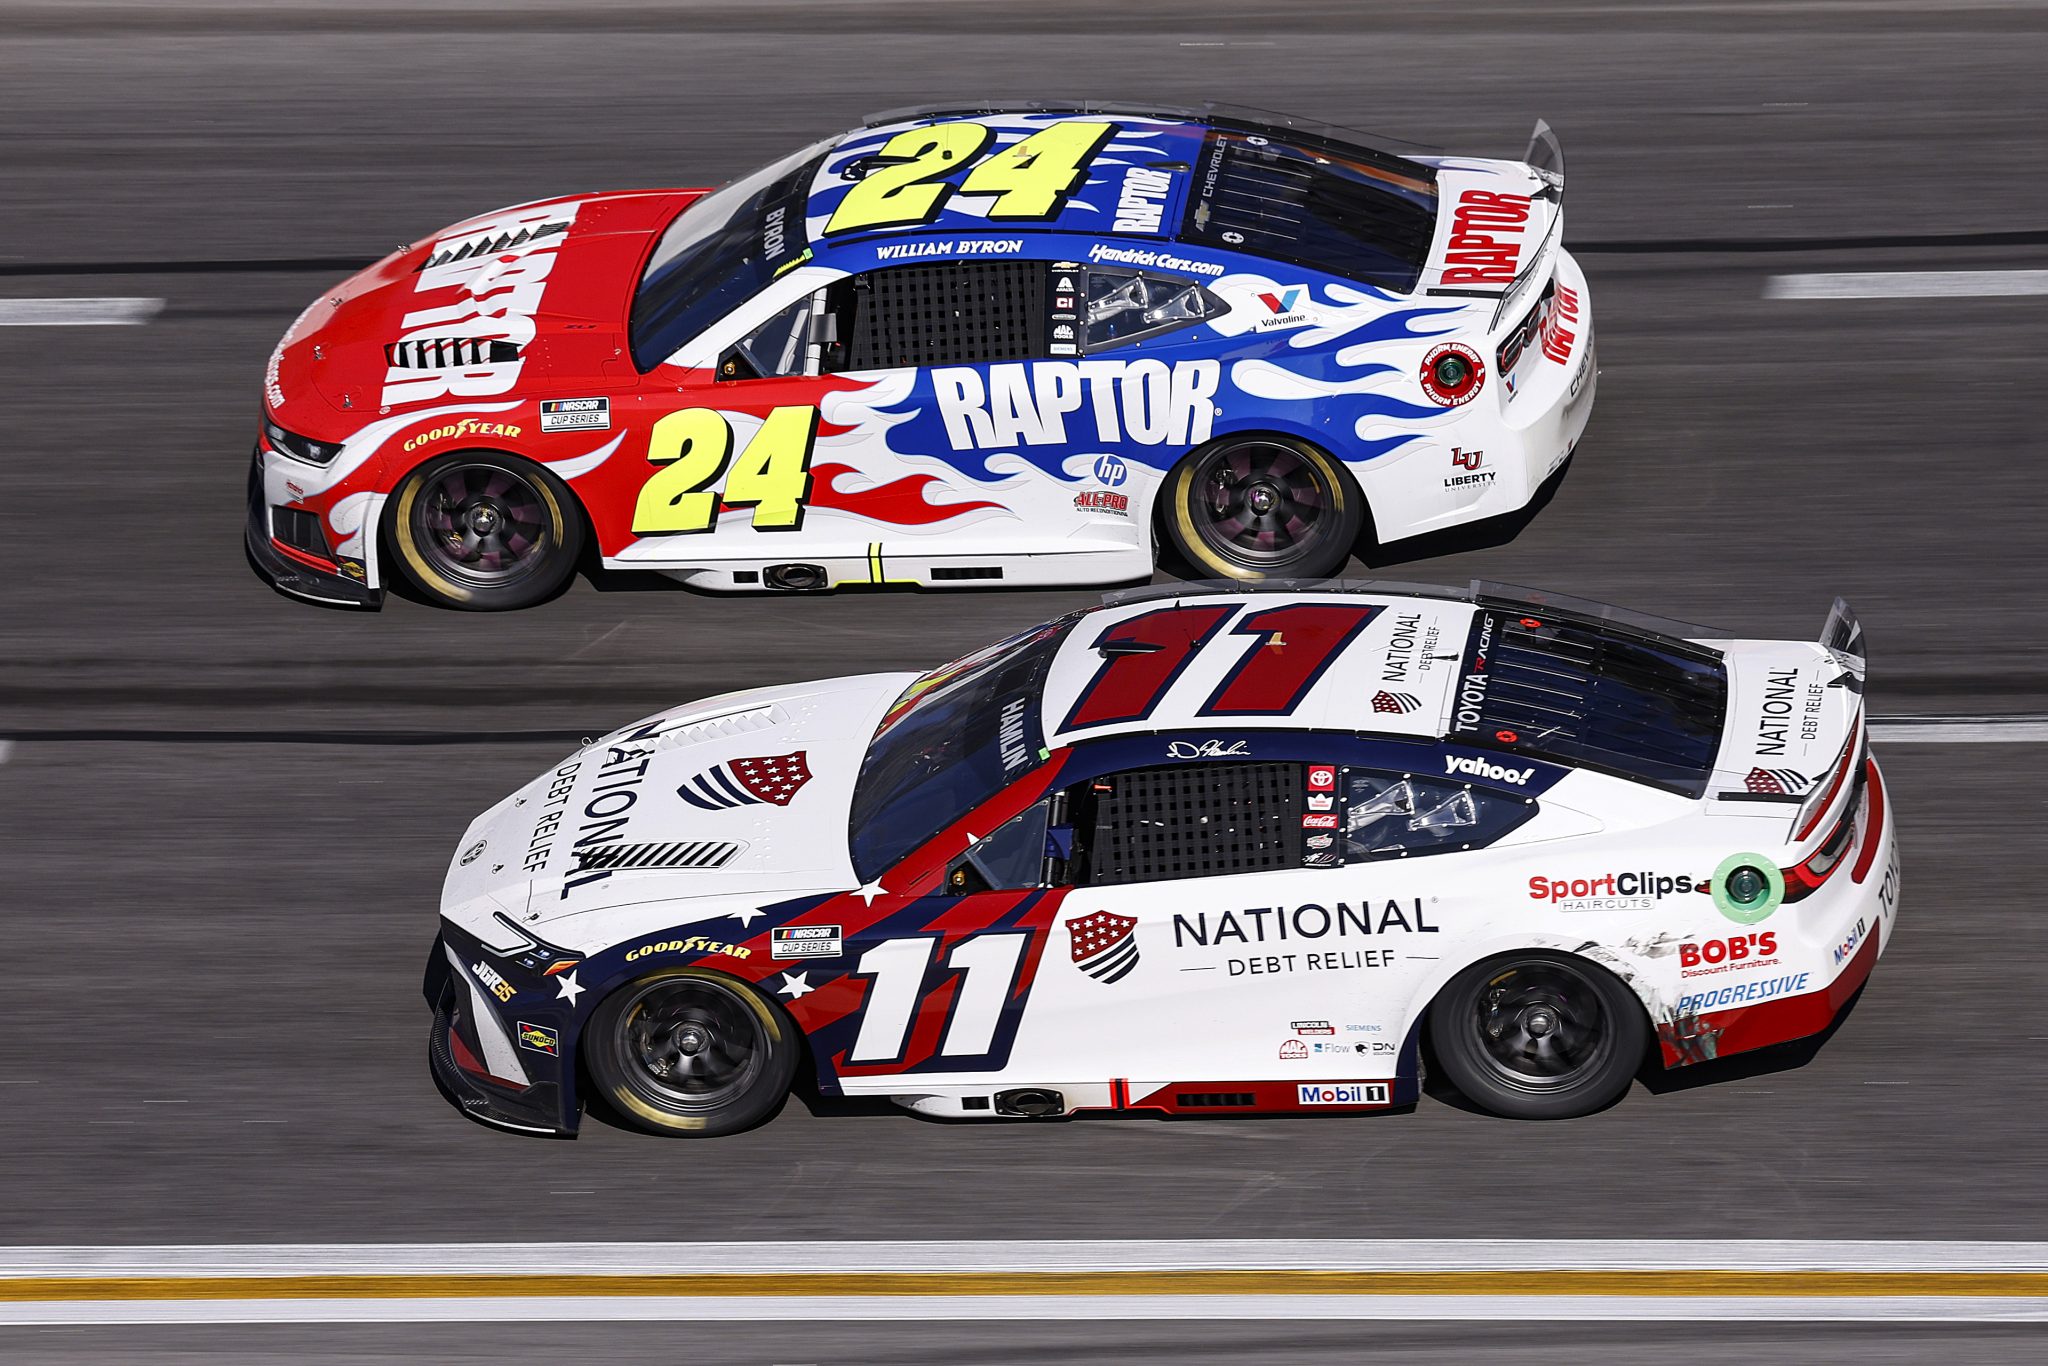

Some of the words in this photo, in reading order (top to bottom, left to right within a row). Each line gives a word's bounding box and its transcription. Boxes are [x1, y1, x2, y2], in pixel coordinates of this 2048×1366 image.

[822, 121, 1118, 238] 24
[1202, 134, 1228, 198] CHEVROLET
[1112, 167, 1172, 233] RAPTOR
[764, 206, 786, 261] BYRON
[1440, 190, 1532, 285] RAPTOR
[877, 241, 953, 259] WILLIAM
[956, 240, 1023, 254] BYRON
[1261, 315, 1305, 327] Valvoline
[1451, 344, 1480, 363] ENERGY
[561, 400, 599, 411] NASCAR
[933, 359, 1220, 450] RAPTOR
[1424, 383, 1451, 405] PHORM
[1453, 380, 1482, 405] ENERGY
[551, 415, 569, 424] CUP
[570, 414, 600, 423] SERIES
[403, 418, 521, 452] GOODYEAR
[631, 405, 821, 535] 24
[1096, 455, 1125, 486] hp
[1444, 472, 1496, 487] LIBERTY
[1076, 491, 1129, 511] ALL-PRO
[1445, 481, 1496, 492] UNIVERSITY
[1382, 614, 1421, 681] NATIONAL
[1423, 626, 1440, 650] RELIEF
[1054, 603, 1389, 736] 11
[1418, 649, 1433, 671] DEBT
[1455, 675, 1488, 731] TOYOTA
[1474, 613, 1494, 673] RACING
[1755, 669, 1798, 755] NATIONAL
[1805, 683, 1824, 712] RELIEF
[1000, 698, 1028, 771] HAMLIN
[1801, 715, 1819, 739] DEBT
[1445, 755, 1536, 785] yahoo!
[544, 762, 582, 808] DEBT
[523, 810, 563, 873] RELIEF
[1563, 899, 1651, 911] HAIRCUTS
[793, 929, 832, 939] NASCAR
[1173, 898, 1440, 948] NATIONAL
[625, 936, 751, 961] GOODYEAR
[782, 944, 800, 952] CUP
[801, 942, 832, 951] SERIES
[1680, 931, 1777, 967] BOB'S
[1228, 955, 1297, 976] DEBT
[1307, 950, 1395, 970] RELIEF
[1681, 965, 1728, 979] Discount
[847, 929, 1030, 1064] 11
[1677, 972, 1810, 1014] PROGRESSIVE
[522, 1032, 555, 1047] SUNOCO
[1324, 1043, 1350, 1053] Flow
[1302, 1086, 1361, 1102] Mobil
